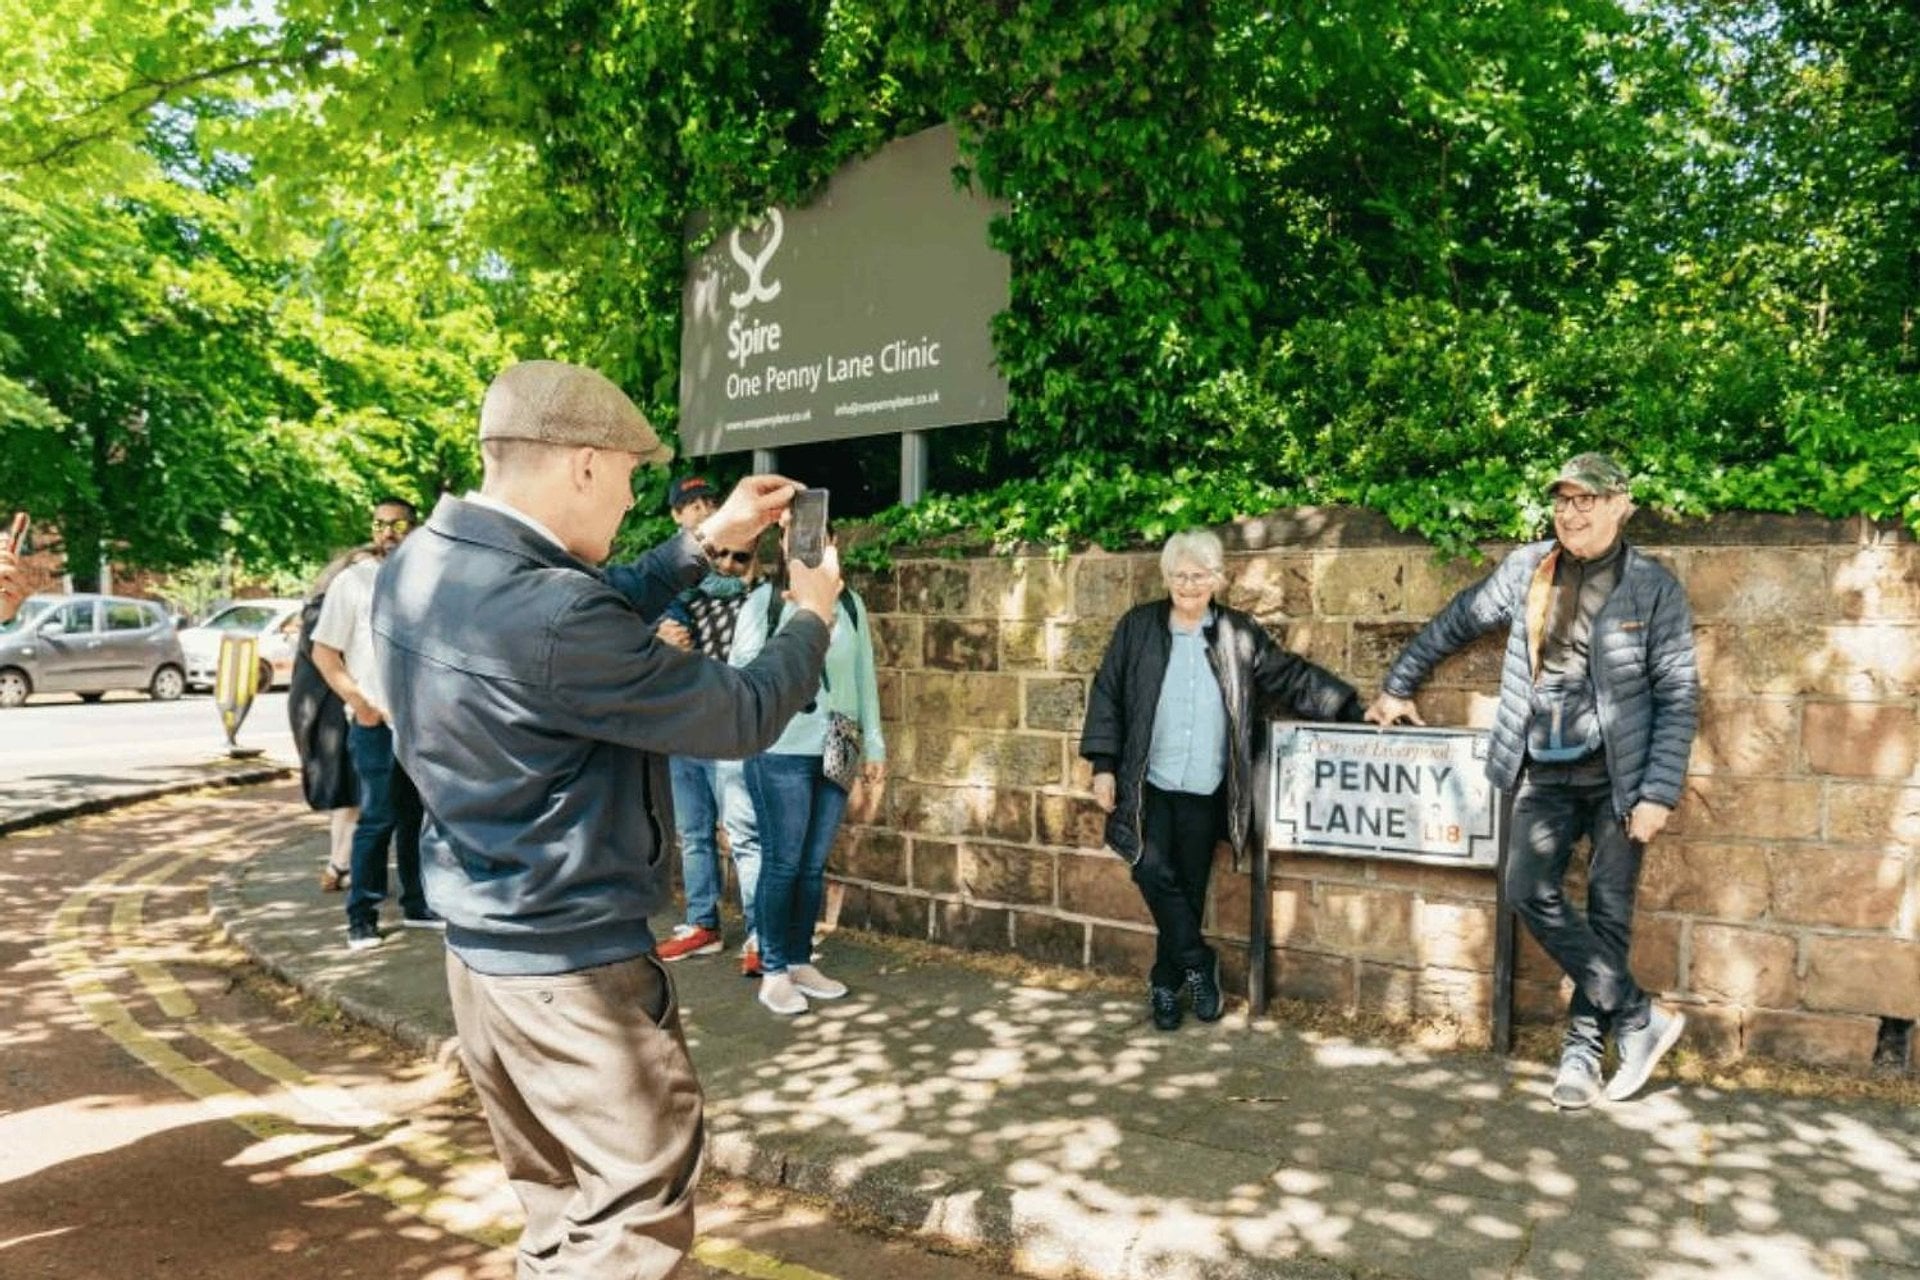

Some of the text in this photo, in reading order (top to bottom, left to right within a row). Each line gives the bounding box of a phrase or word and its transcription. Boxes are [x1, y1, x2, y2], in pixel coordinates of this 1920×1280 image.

[727, 318, 781, 368] Spire
[726, 336, 941, 399] One Penny Lane Clinic
[1315, 759, 1452, 795] PENNY
[1305, 800, 1407, 838] LANE
[1424, 822, 1461, 843] L18
